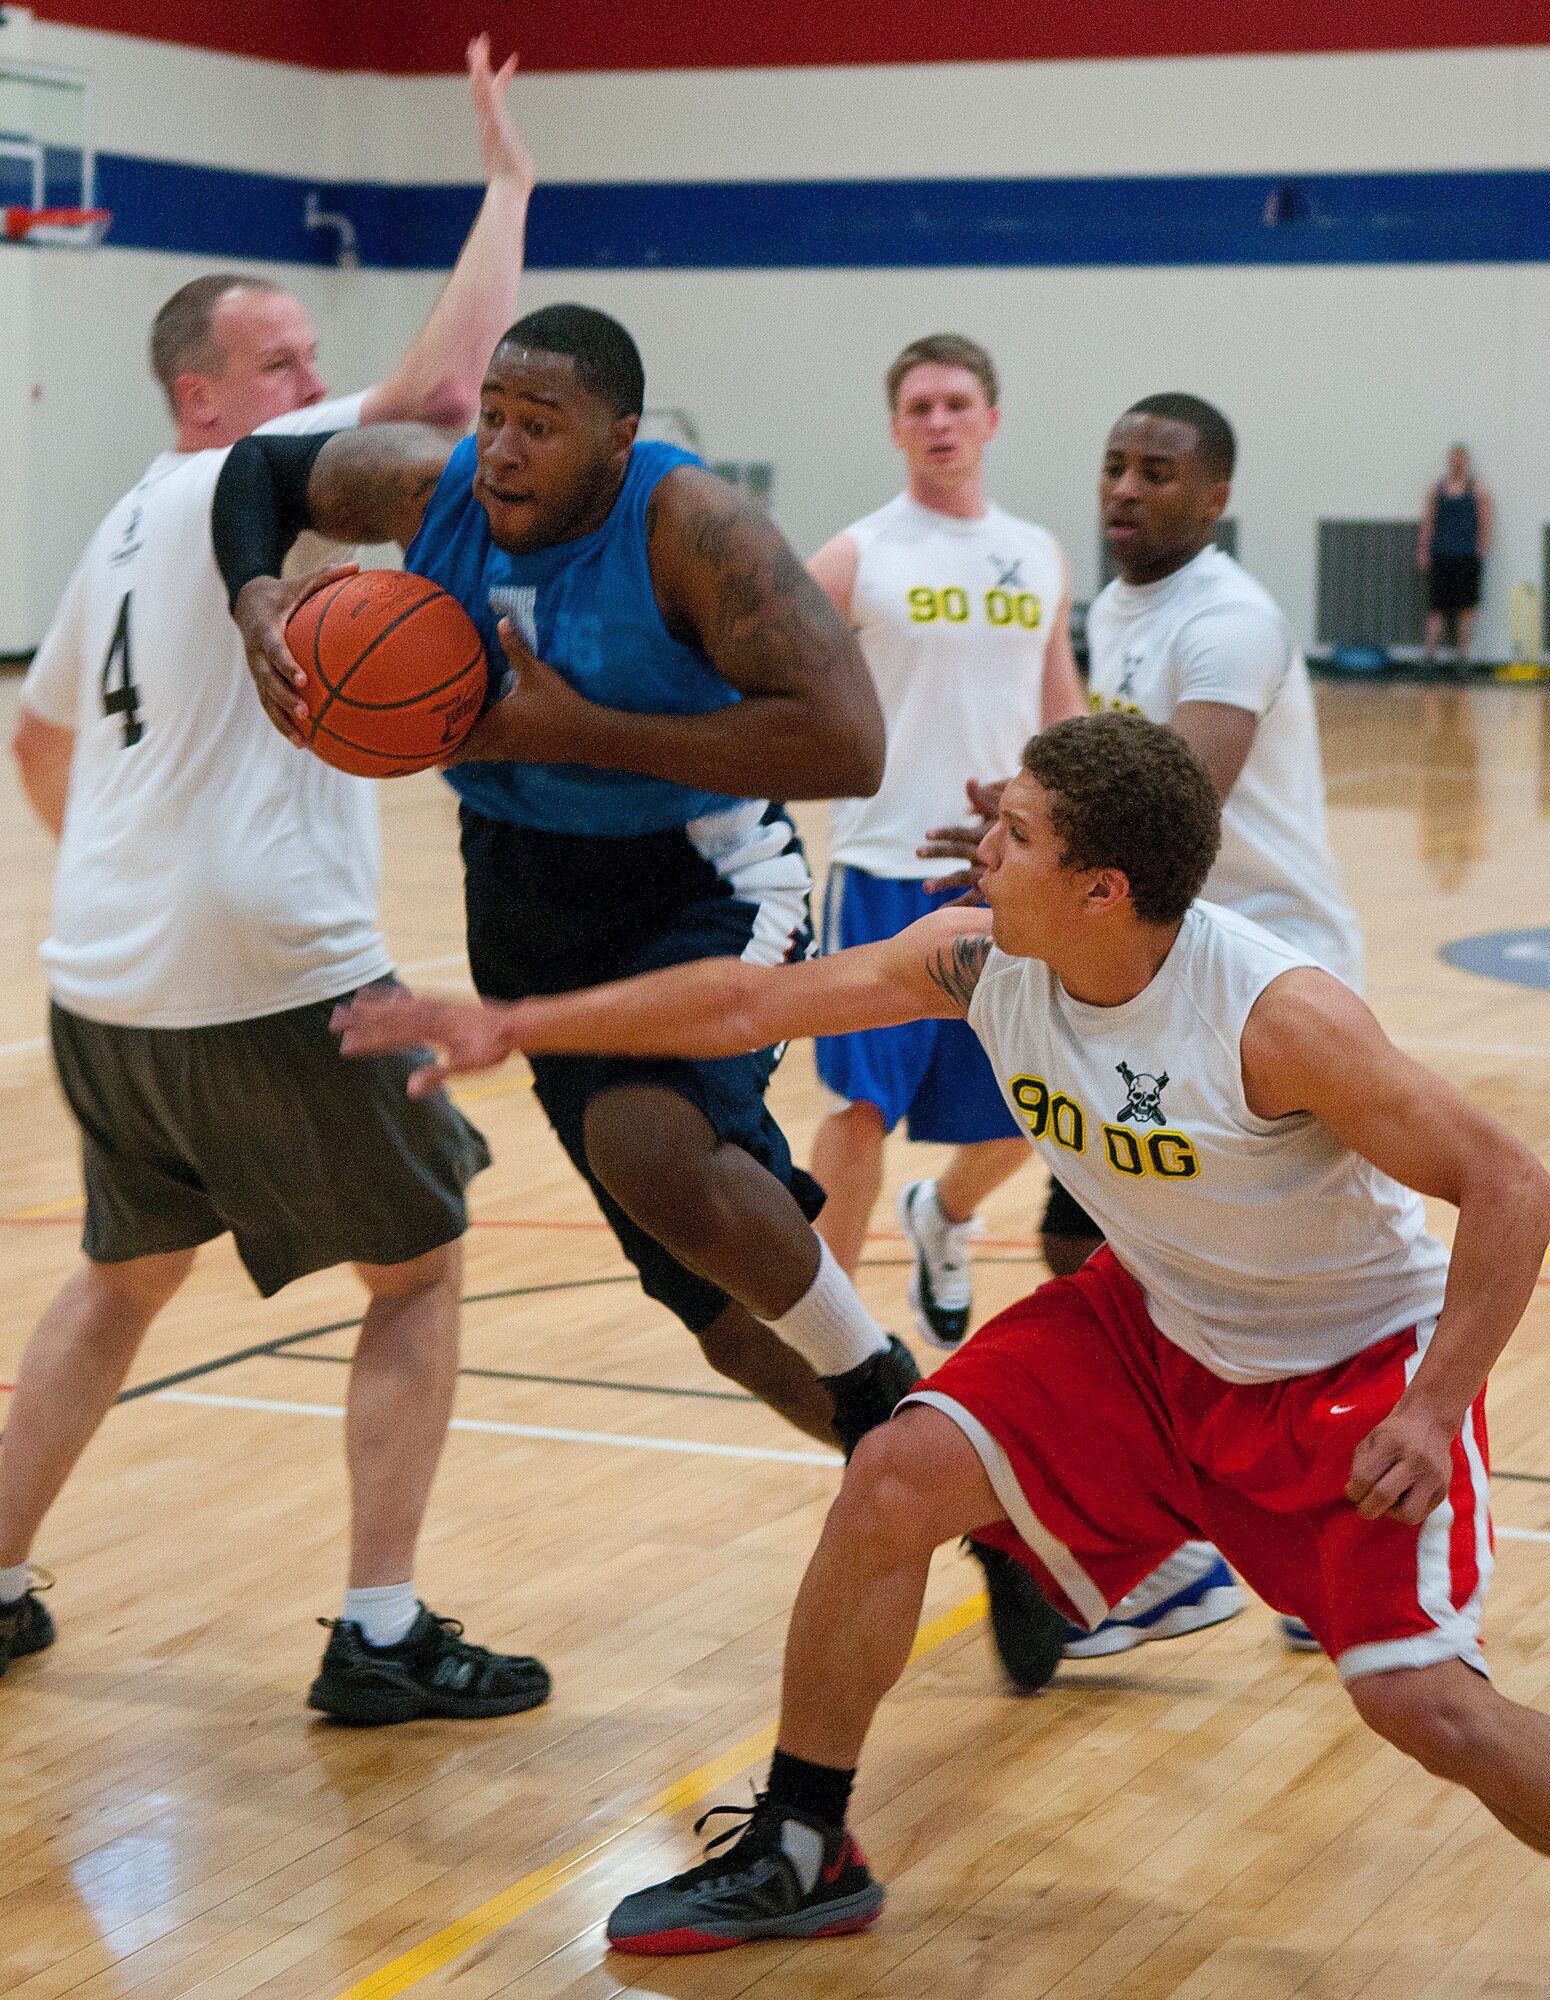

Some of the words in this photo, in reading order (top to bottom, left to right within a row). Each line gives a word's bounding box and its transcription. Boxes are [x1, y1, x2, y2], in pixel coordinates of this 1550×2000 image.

[907, 586, 969, 624] 90
[101, 588, 146, 749] 4
[1009, 1073, 1087, 1156] 90
